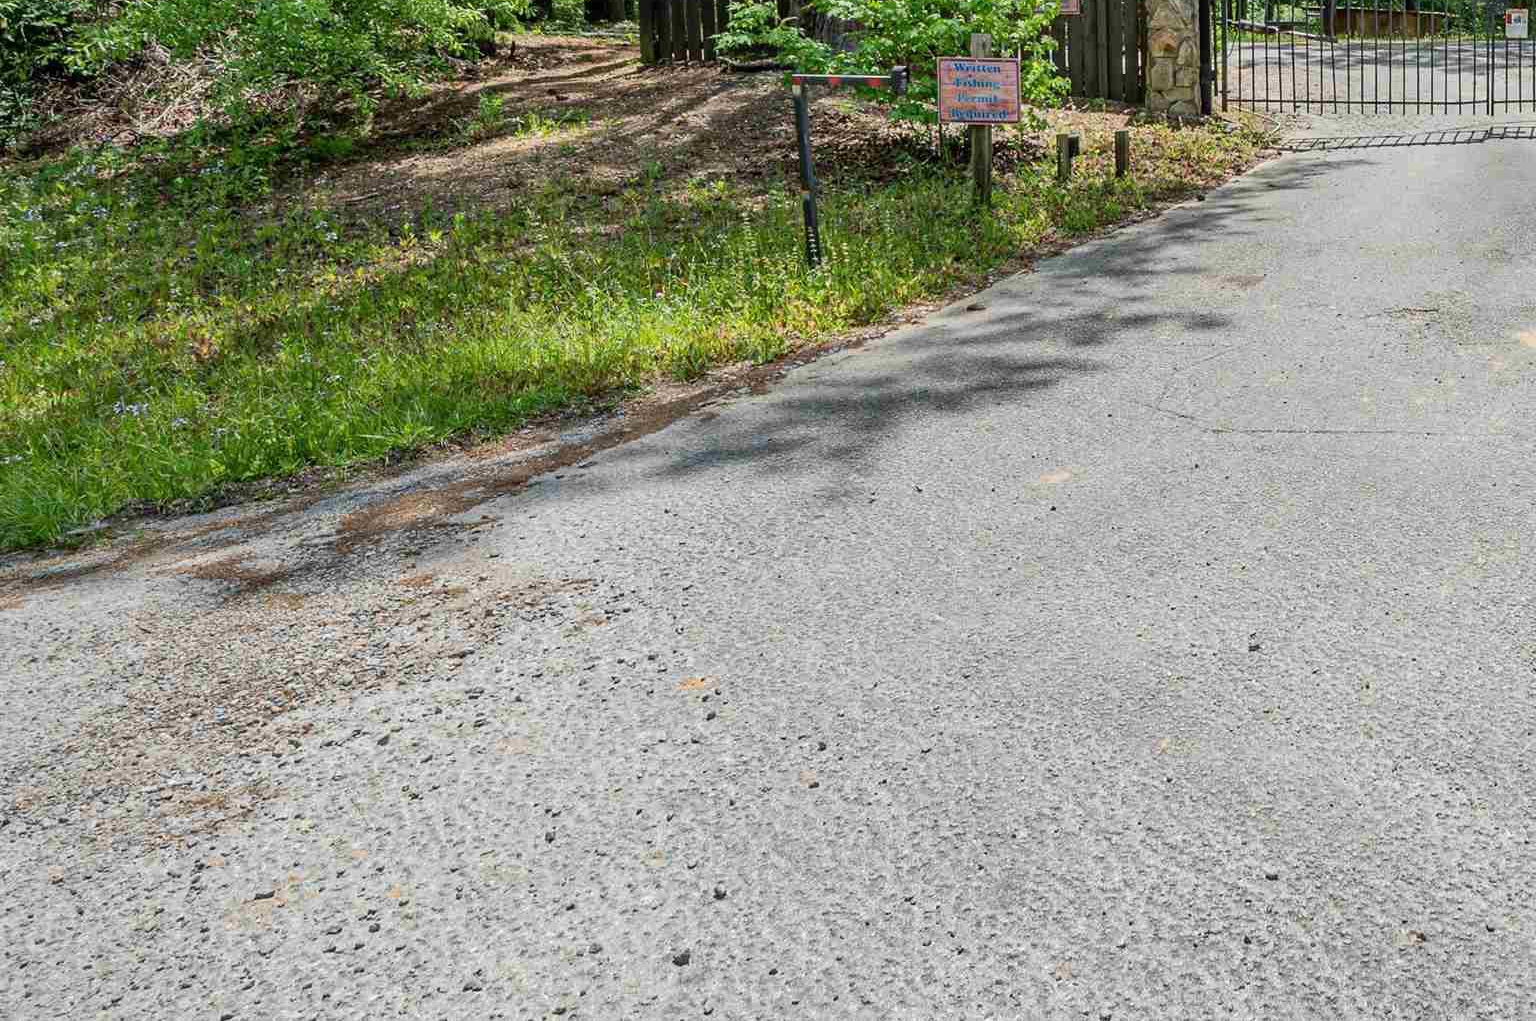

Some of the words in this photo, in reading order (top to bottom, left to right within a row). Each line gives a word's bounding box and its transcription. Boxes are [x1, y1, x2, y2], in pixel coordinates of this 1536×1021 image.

[953, 63, 1001, 73] Written
[954, 78, 1001, 91] Fishing
[956, 93, 999, 103] Permit
[951, 109, 1009, 120] Required
